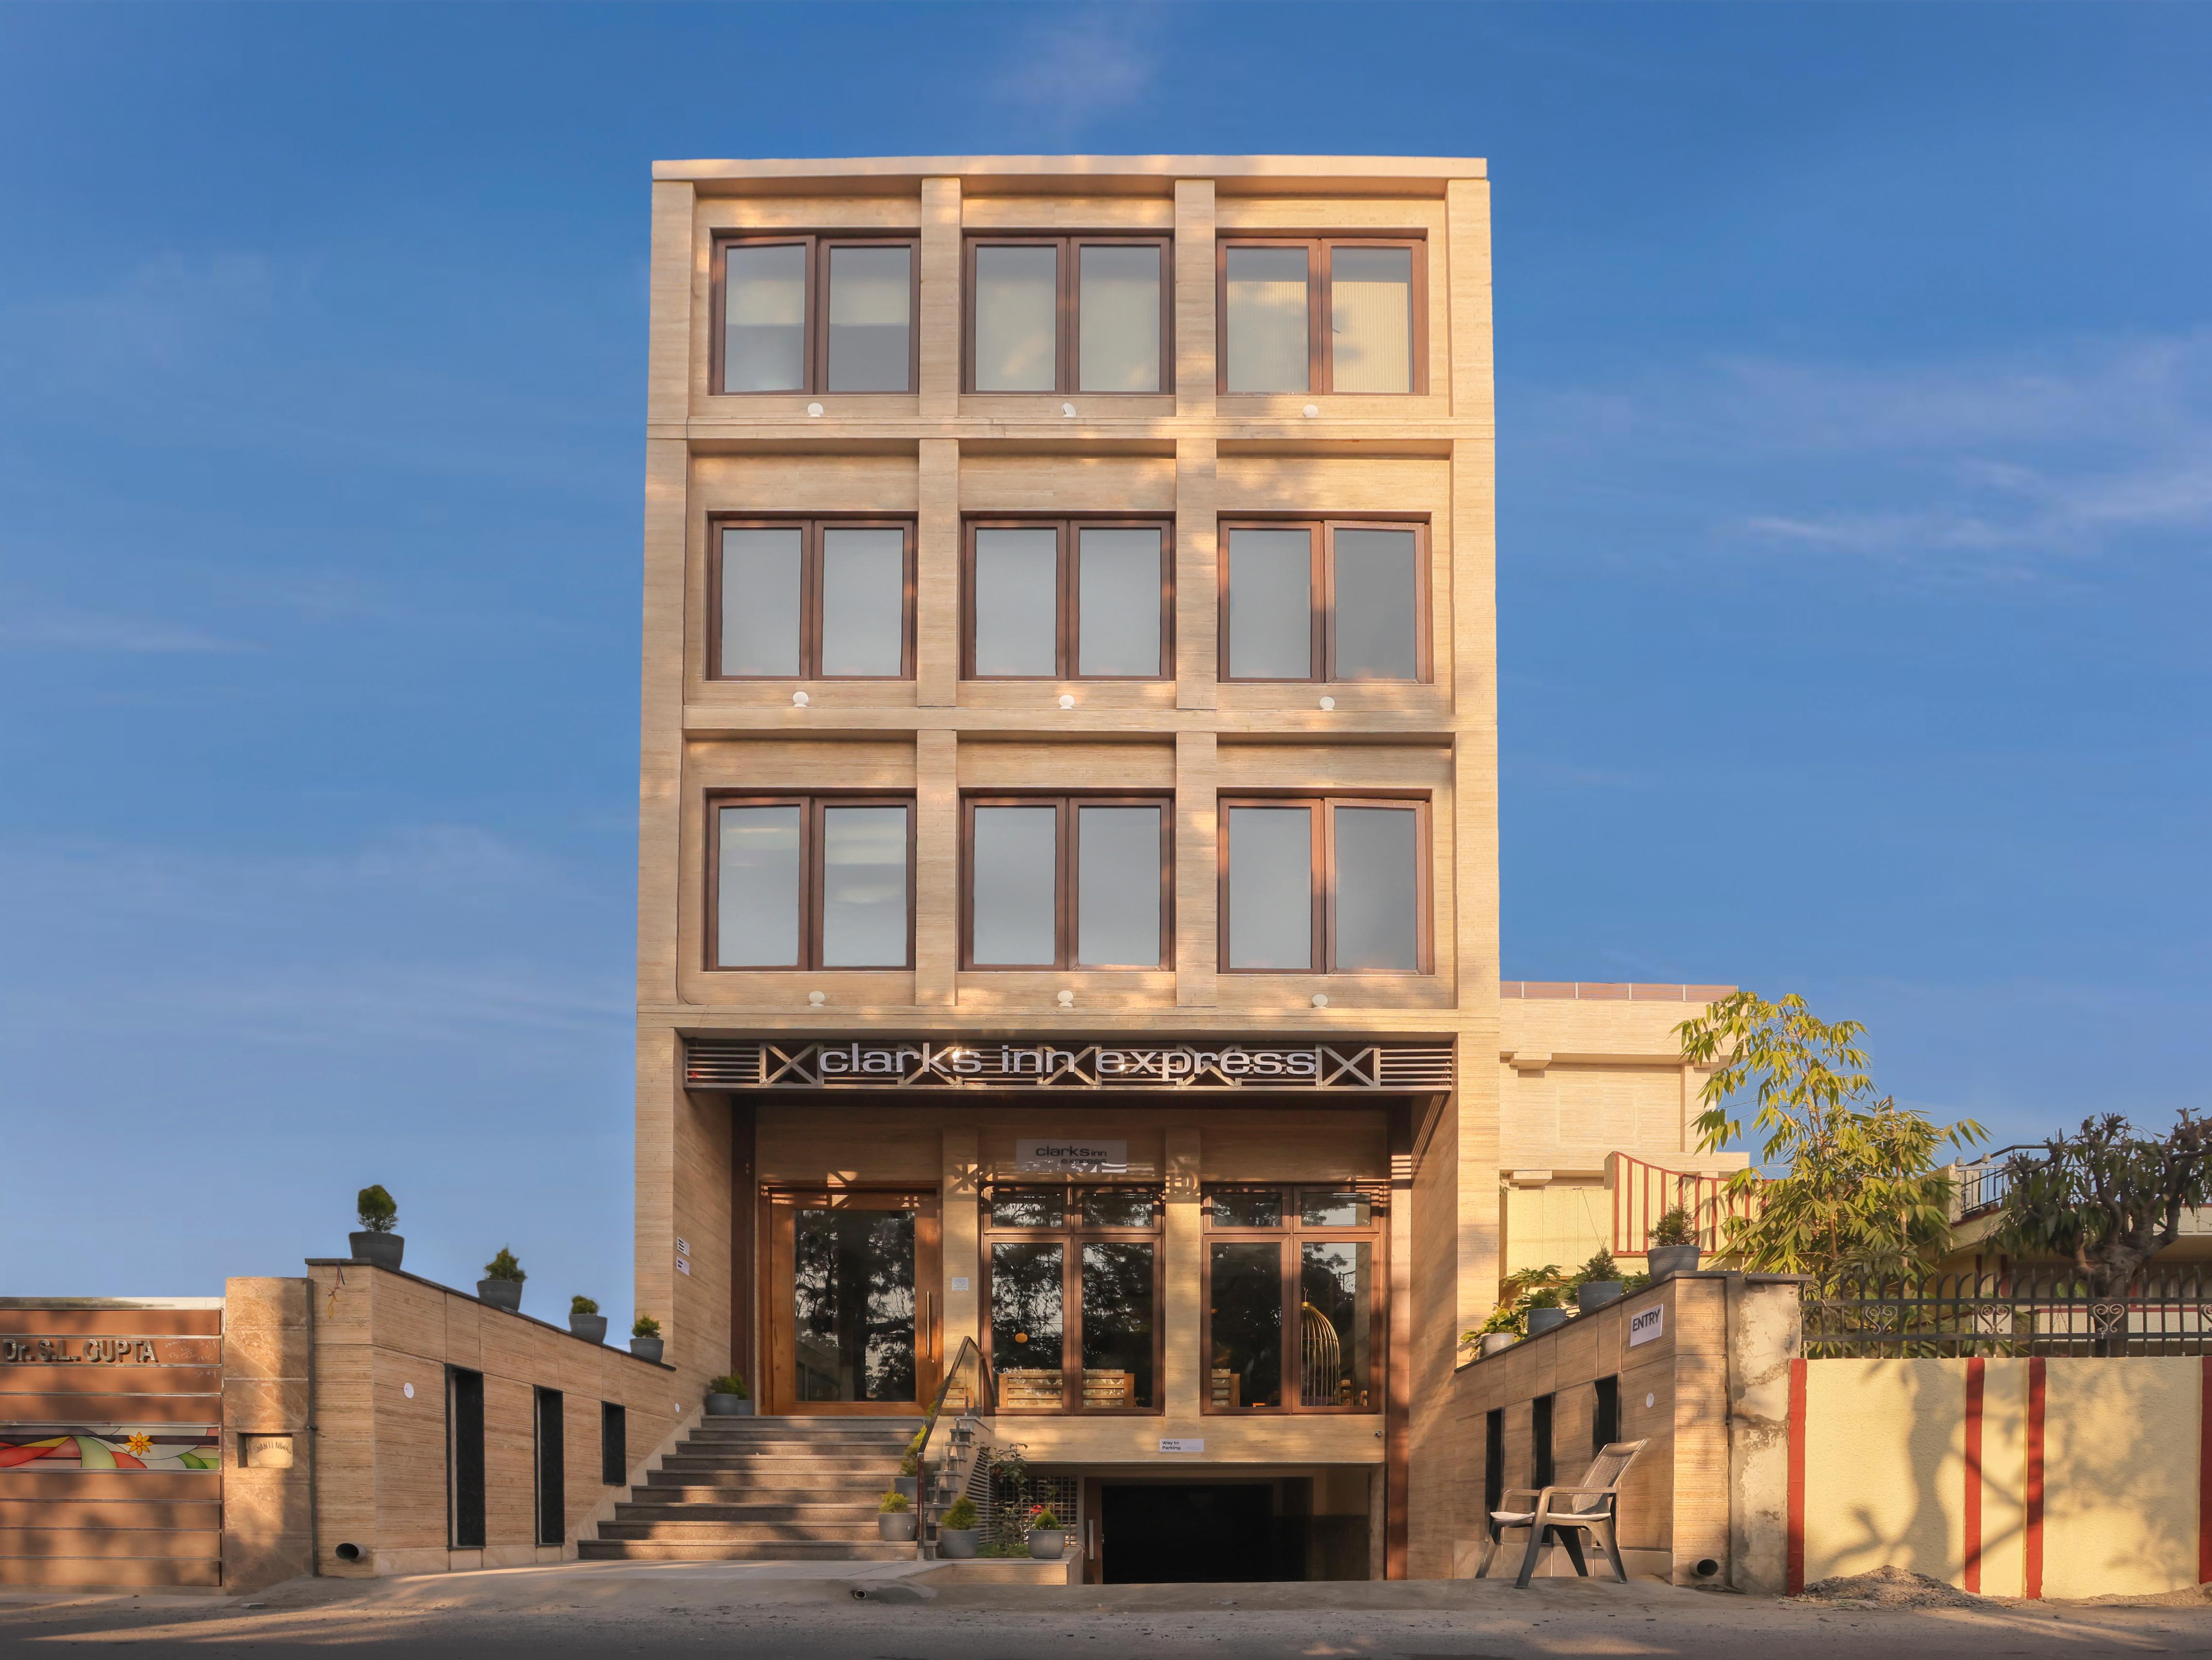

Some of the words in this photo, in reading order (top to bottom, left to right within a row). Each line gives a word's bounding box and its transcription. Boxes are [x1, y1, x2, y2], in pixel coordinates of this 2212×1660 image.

[819, 1042, 982, 1073] clarks
[1002, 1045, 1075, 1073] inn
[1096, 1051, 1315, 1082] express
[1036, 1145, 1090, 1157] clarks
[1633, 1308, 1661, 1332] ENTRY
[2, 1339, 32, 1361] Dr.
[83, 1339, 157, 1362] GUPTA
